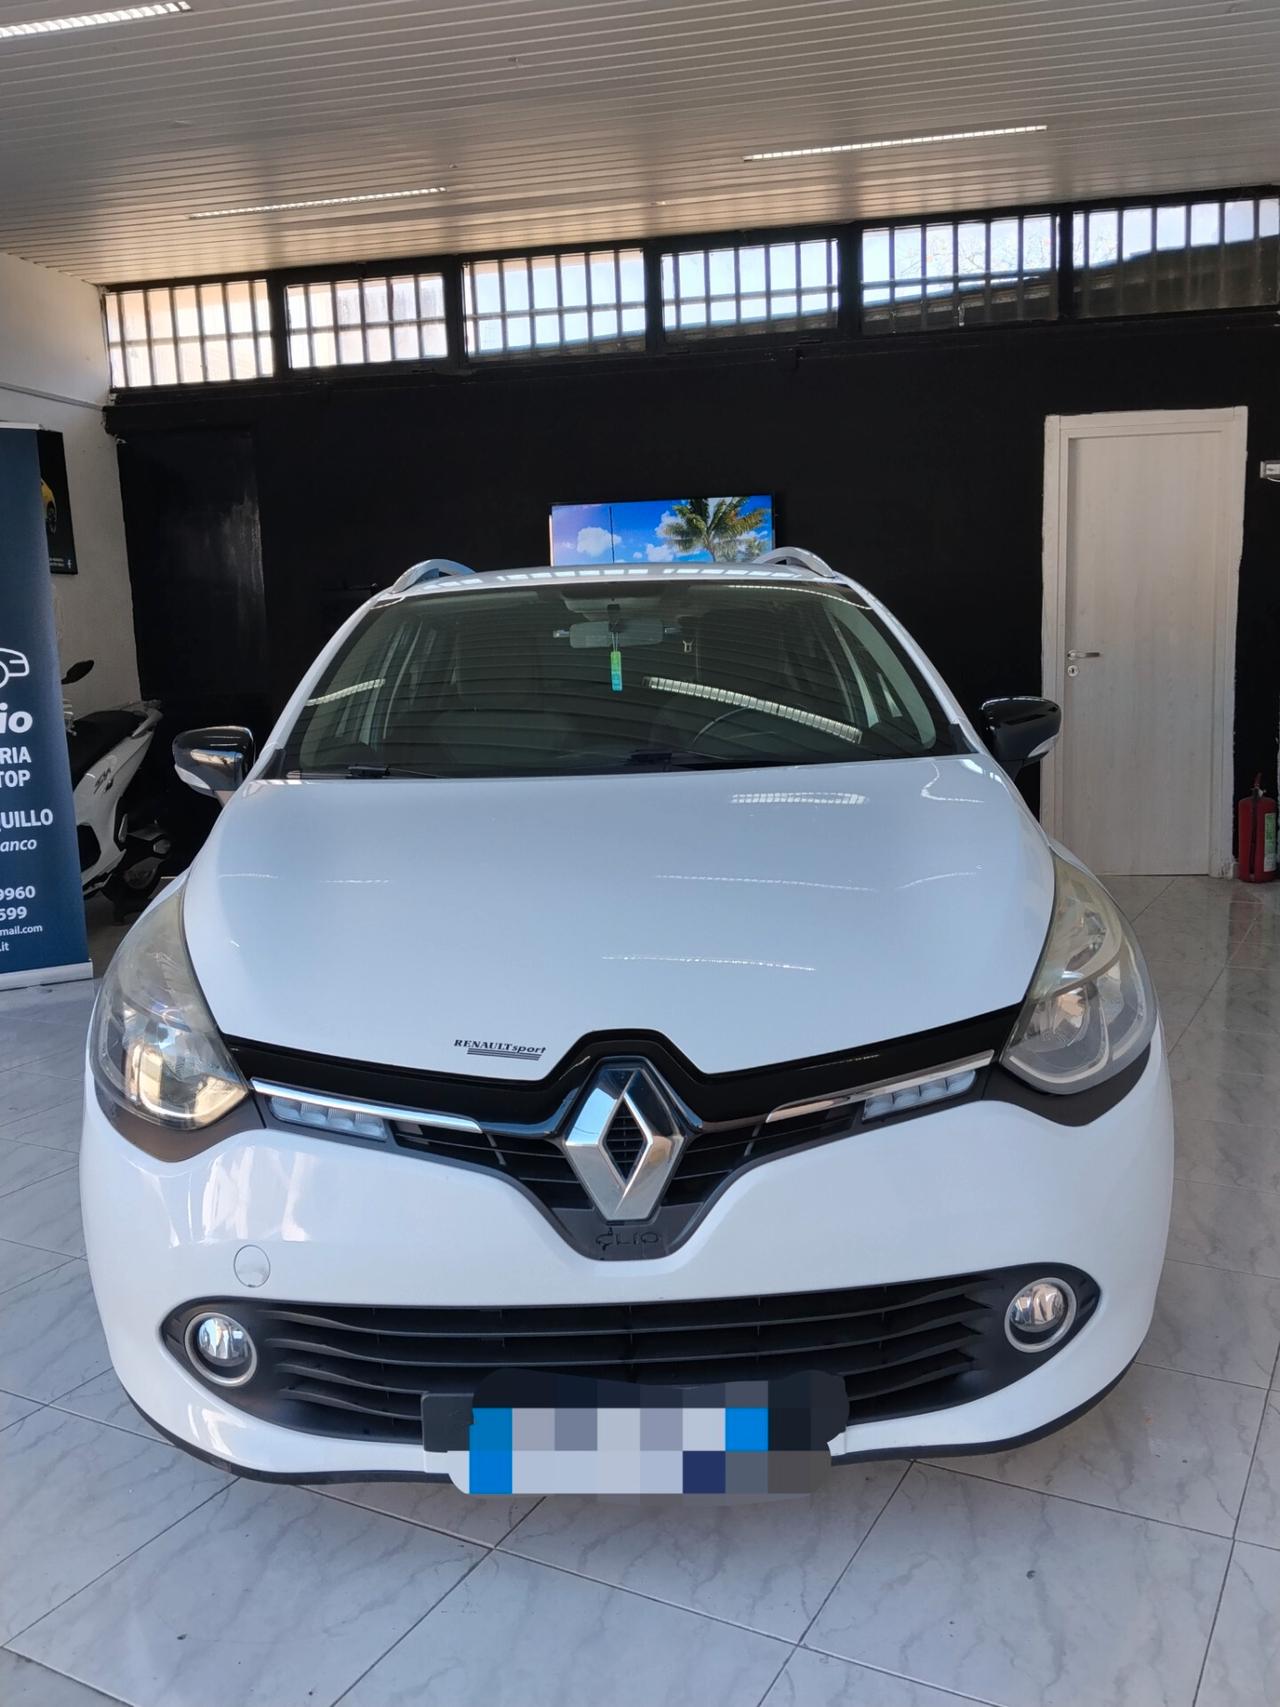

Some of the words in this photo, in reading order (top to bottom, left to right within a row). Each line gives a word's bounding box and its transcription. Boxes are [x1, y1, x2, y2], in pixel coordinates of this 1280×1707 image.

[0, 746, 32, 764] RIA
[0, 808, 54, 832] UILLO
[0, 839, 37, 852] anco
